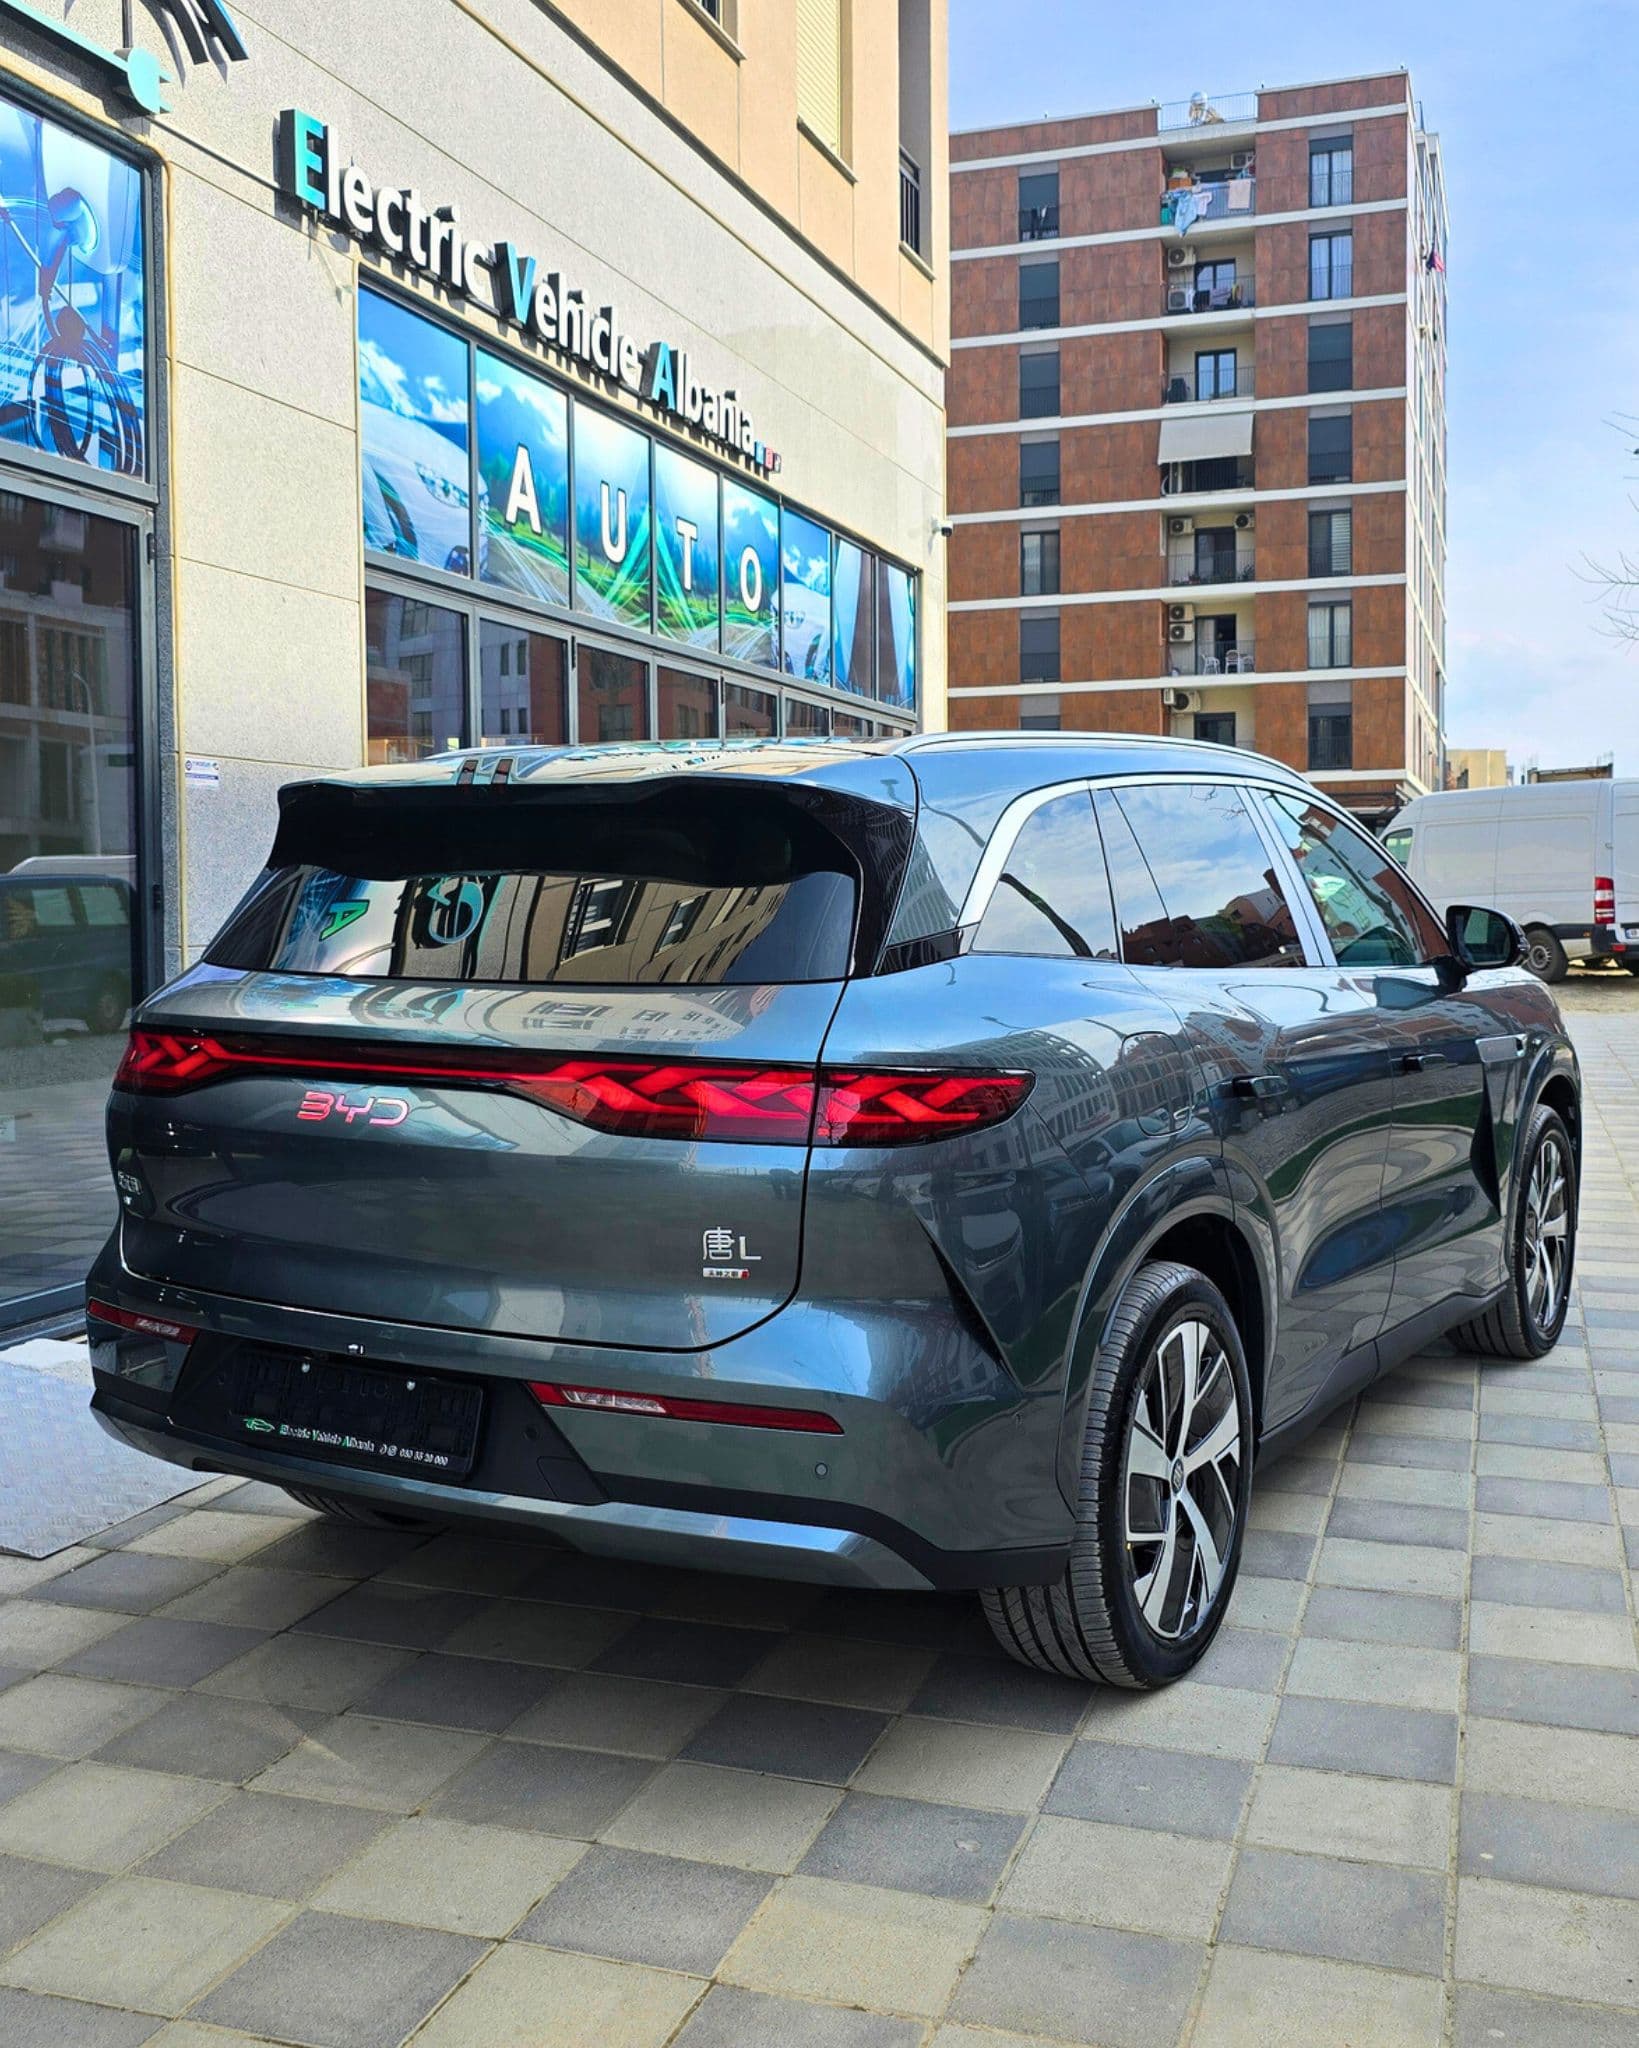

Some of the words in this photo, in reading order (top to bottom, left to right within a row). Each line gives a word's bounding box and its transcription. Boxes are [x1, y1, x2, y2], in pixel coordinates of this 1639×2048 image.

[281, 108, 490, 299] Electric
[496, 240, 642, 384] Vehicle
[649, 341, 756, 454] Albania
[296, 1089, 409, 1127] BYD
